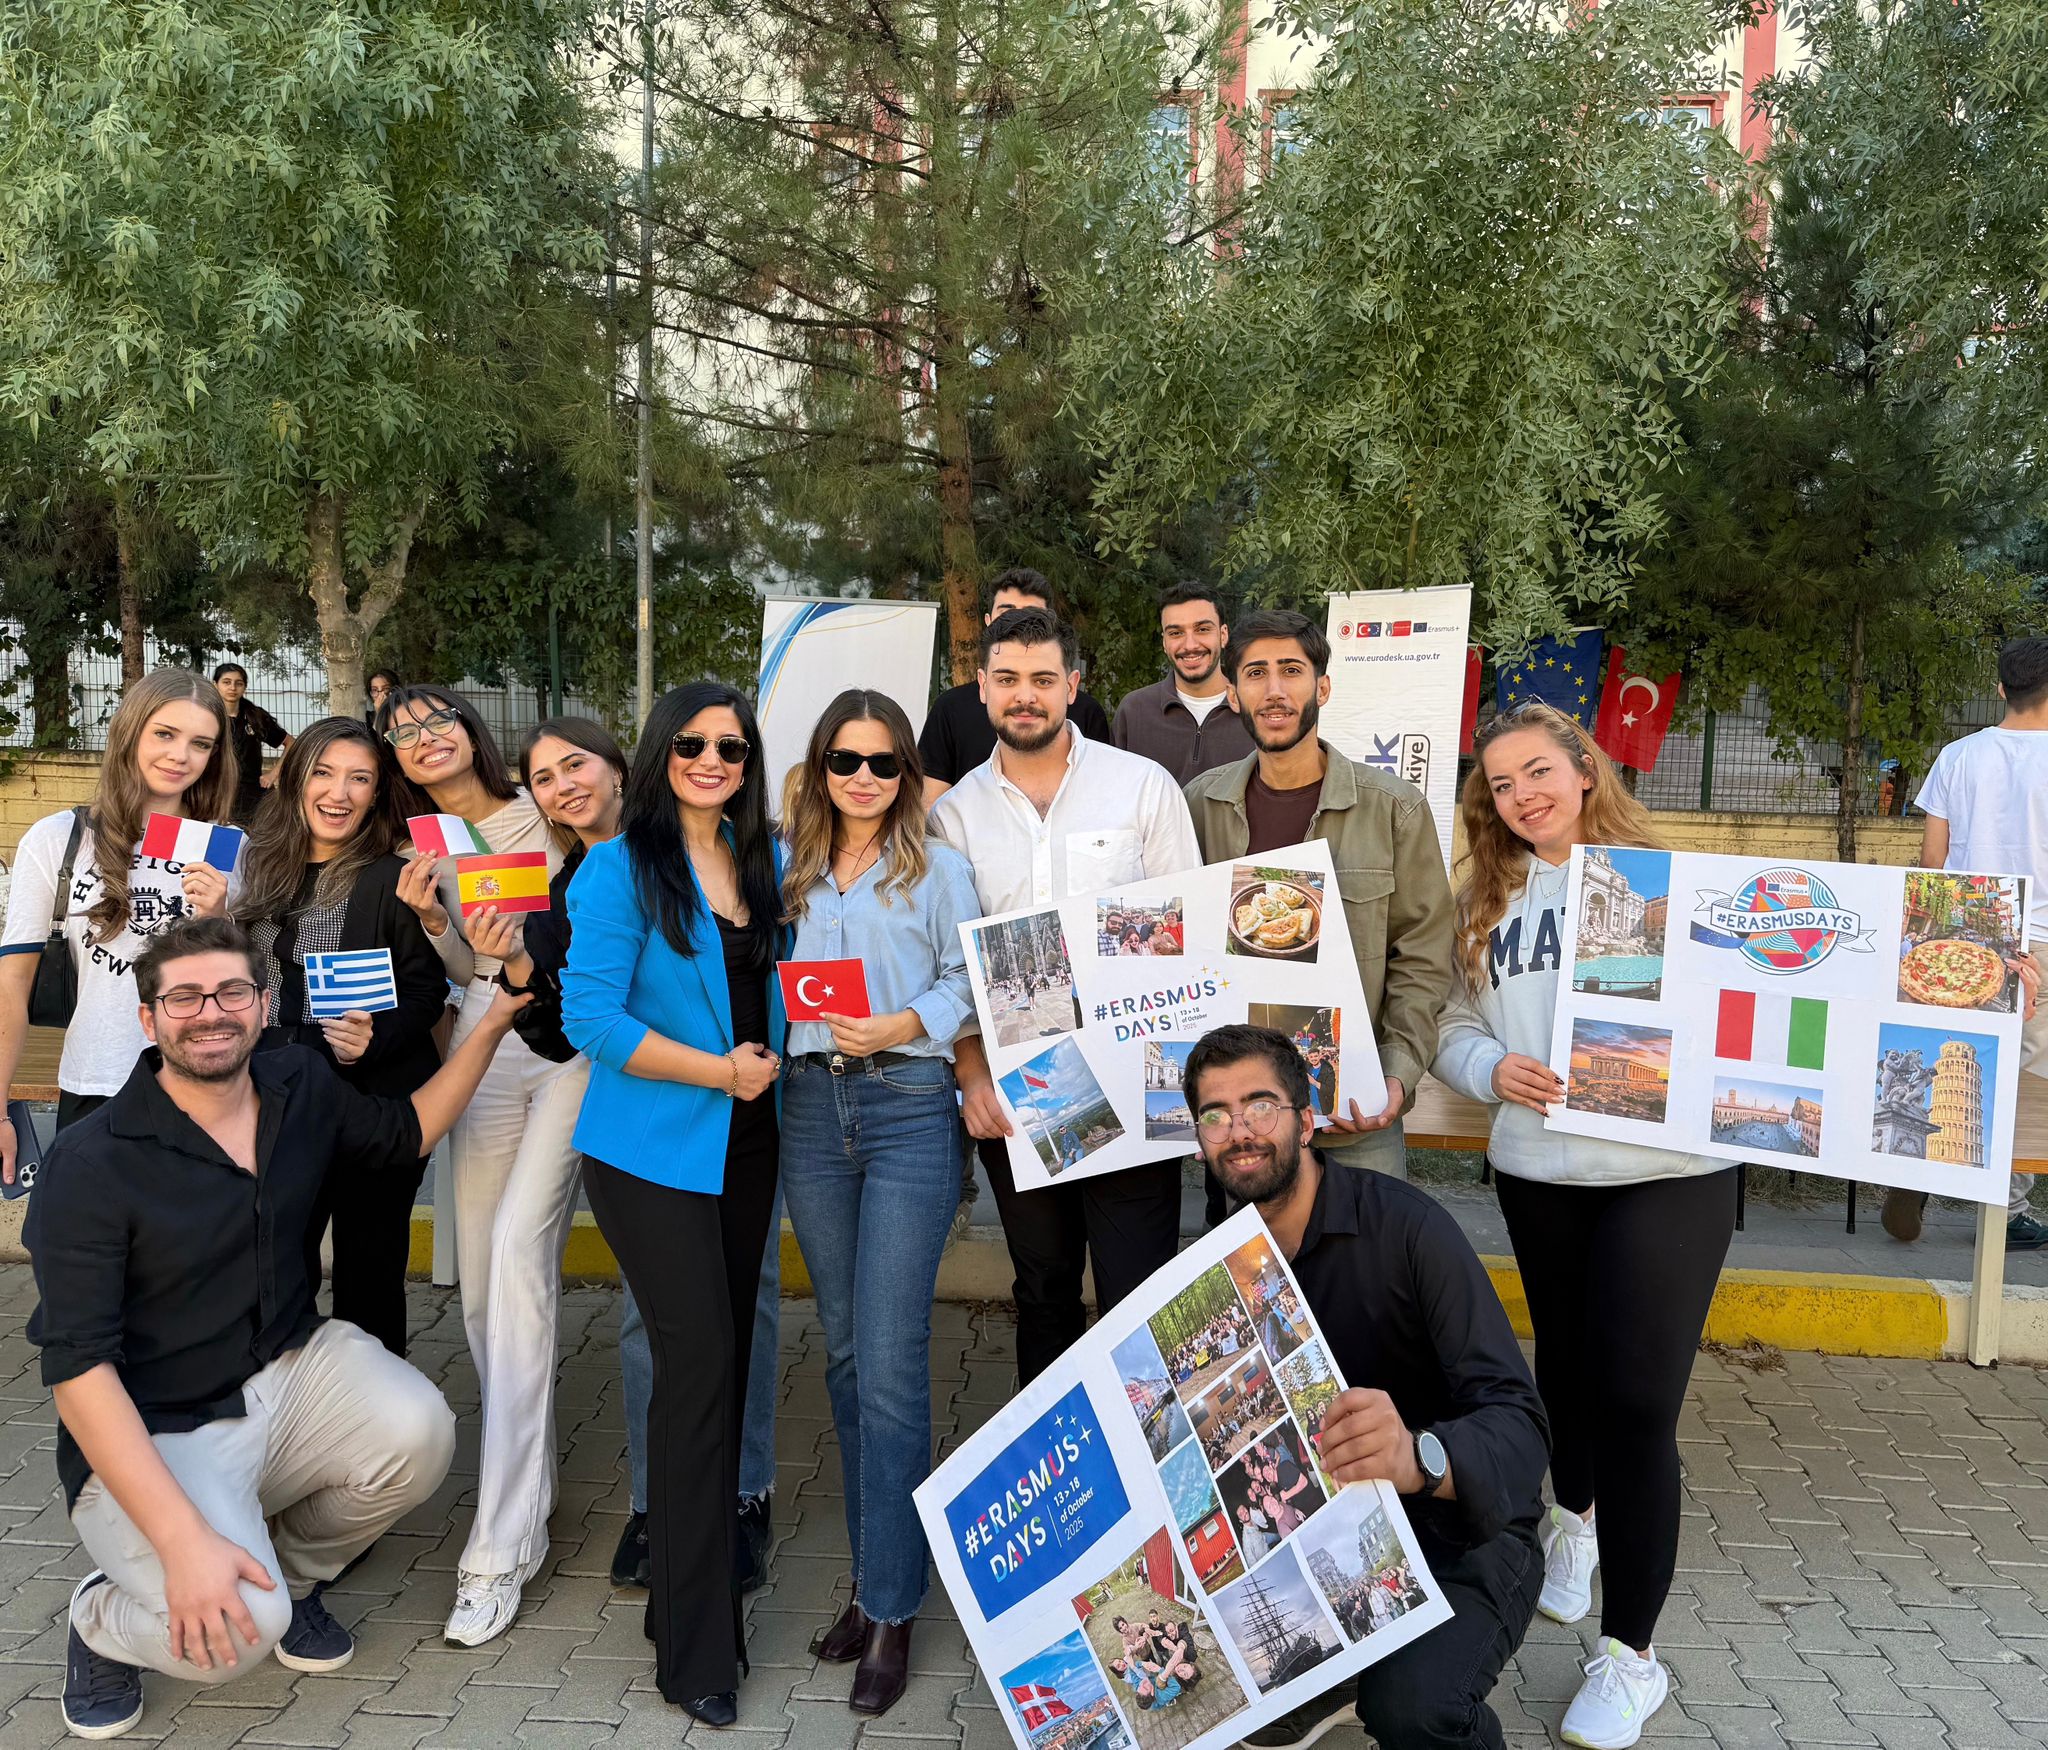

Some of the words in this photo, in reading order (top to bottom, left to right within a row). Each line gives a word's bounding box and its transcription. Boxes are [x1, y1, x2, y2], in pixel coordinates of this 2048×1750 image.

[1344, 652, 1440, 662] www.eurodesk.ua.gov.tr
[1406, 742, 1426, 784] kiye
[1716, 911, 1853, 931] #ERASMUSDAYS
[1488, 906, 1566, 991] MA
[1094, 980, 1216, 1021] #ERASMUS
[1187, 1013, 1207, 1022] October
[1114, 1014, 1172, 1042] DAYS
[964, 1433, 1080, 1559] #ERASMUS
[1053, 1491, 1065, 1507] 13
[1069, 1476, 1080, 1492] 18
[1060, 1508, 1069, 1524] of
[1067, 1486, 1094, 1516] October
[1065, 1516, 1084, 1541] 2025
[989, 1515, 1047, 1583] DAYS
